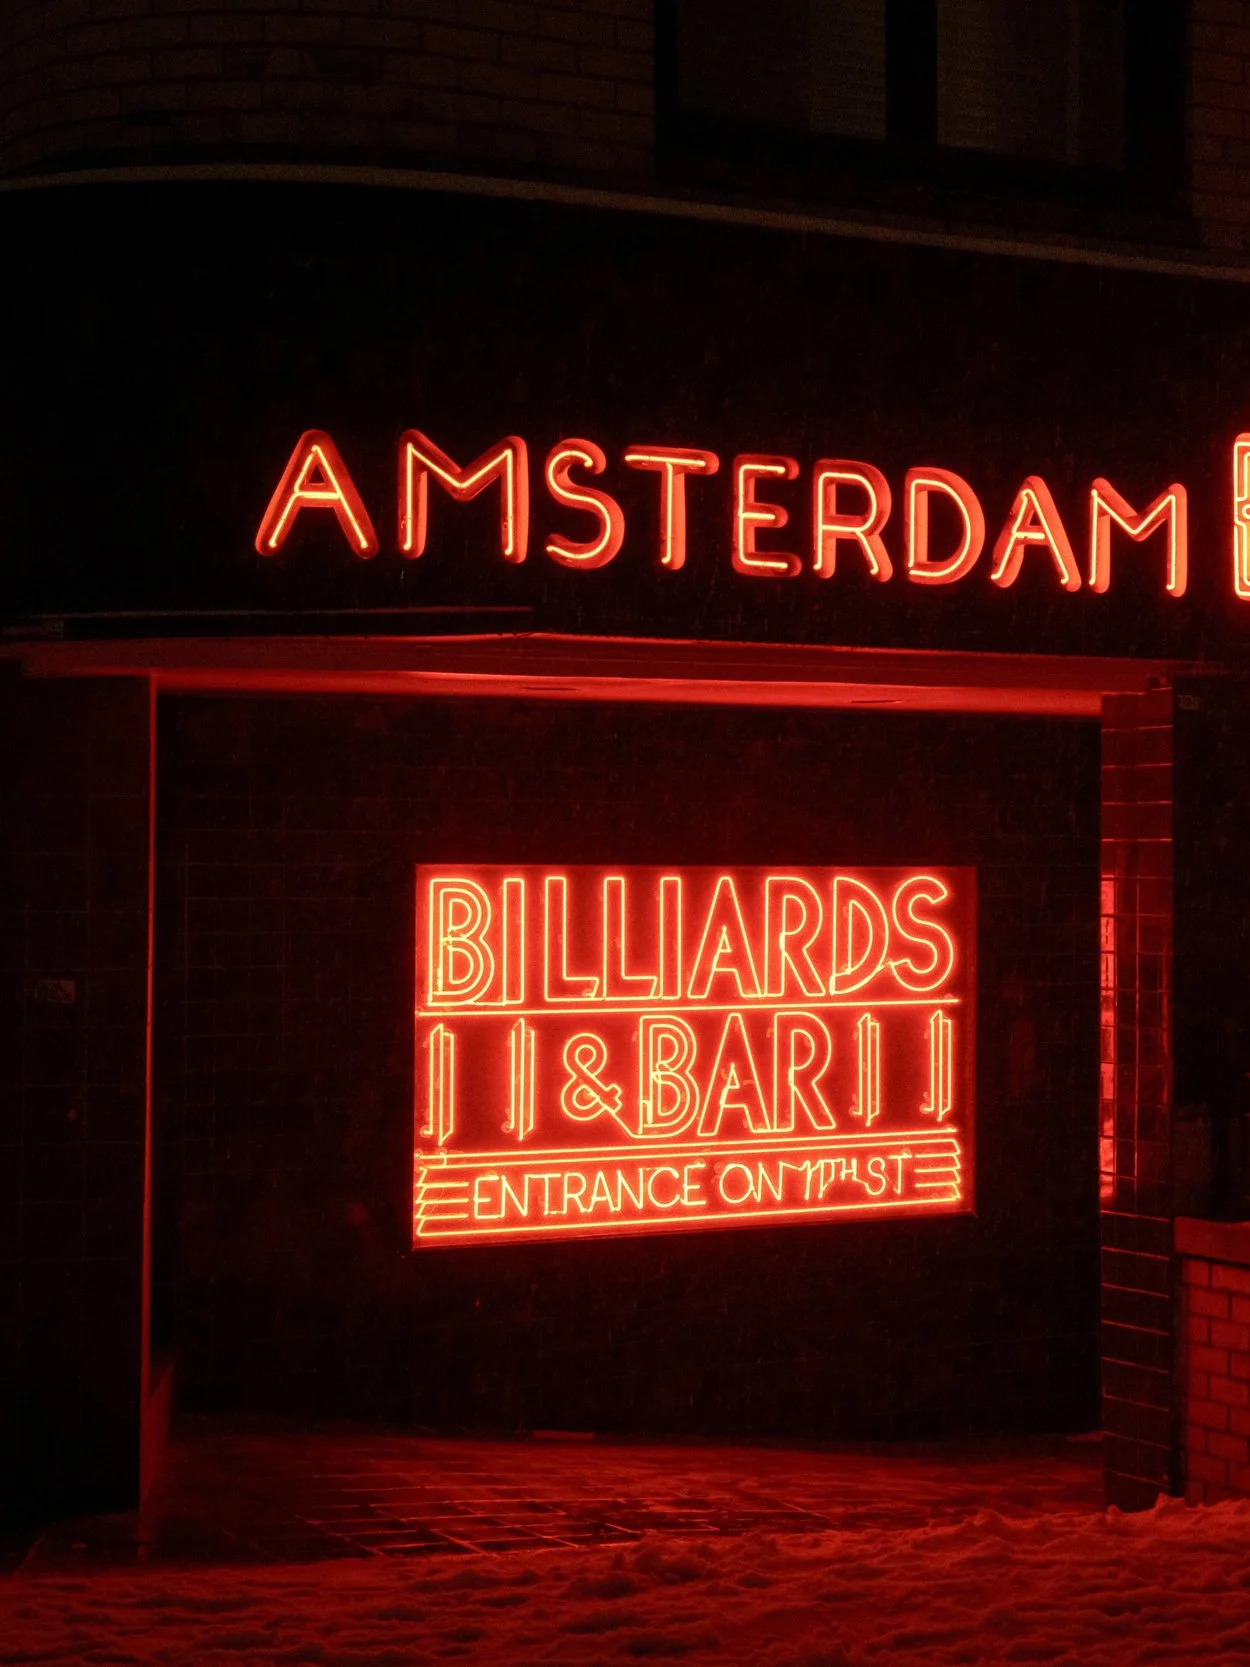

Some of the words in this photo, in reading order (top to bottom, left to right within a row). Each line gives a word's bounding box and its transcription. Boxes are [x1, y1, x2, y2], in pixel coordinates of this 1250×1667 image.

[253, 428, 1188, 598] AMSTERDAM
[427, 876, 953, 1006] BILLIARDS
[561, 1033, 622, 1122] &
[637, 1011, 836, 1138] BAR
[473, 1162, 706, 1219] ENTRANCE
[719, 1160, 783, 1203] ON
[866, 1153, 912, 1196] ST
